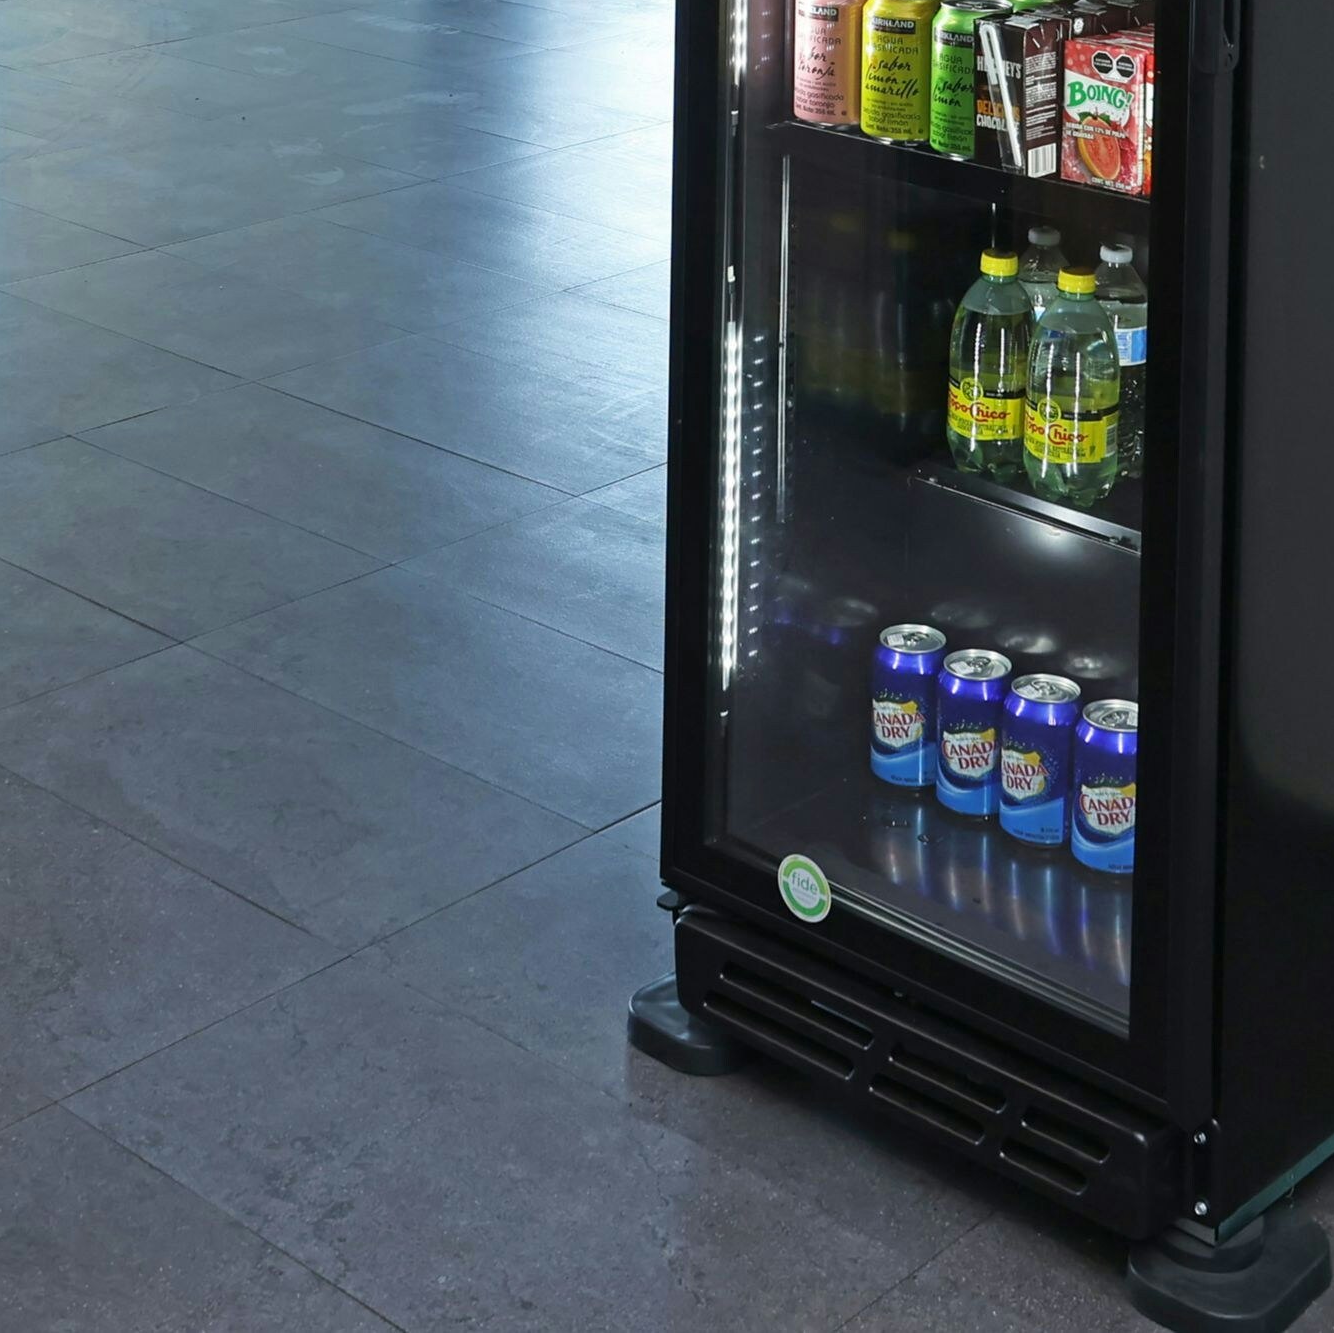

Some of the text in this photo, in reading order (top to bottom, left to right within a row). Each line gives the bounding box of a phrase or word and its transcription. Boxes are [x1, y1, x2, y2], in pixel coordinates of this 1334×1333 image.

[877, 35, 904, 45] AGUA
[865, 78, 919, 99] amarillo
[1066, 80, 1135, 109] BOING!
[970, 401, 1012, 422] Chico
[1047, 423, 1089, 446] Chico
[882, 725, 911, 739] DRY
[941, 739, 995, 760] CANAD
[959, 754, 990, 770] DRY
[1007, 777, 1033, 791] DRY
[1079, 793, 1134, 815] CANAD
[1097, 811, 1130, 826] DRY
[792, 871, 818, 896] fide
